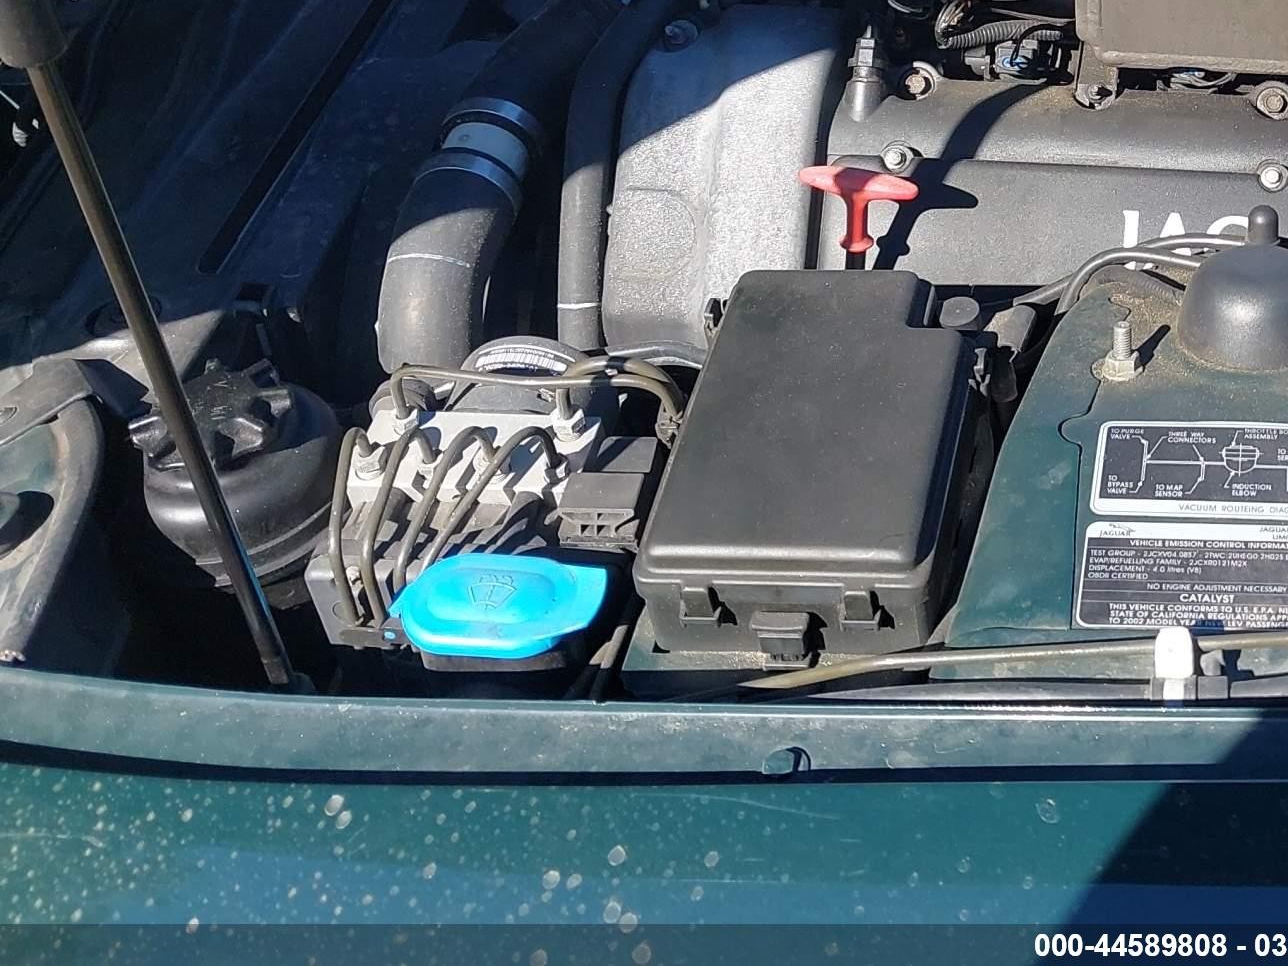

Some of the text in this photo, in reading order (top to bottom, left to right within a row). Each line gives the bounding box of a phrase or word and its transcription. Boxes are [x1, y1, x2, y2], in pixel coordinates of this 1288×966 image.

[1179, 504, 1217, 512] VACUUM
[1221, 505, 1265, 513] ROUTEING
[1130, 539, 1163, 547] VEHICLE
[1165, 540, 1204, 548] EMISSION
[1206, 541, 1246, 549] CONTROL
[1155, 558, 1181, 566] FAMILY
[1111, 572, 1149, 580] CERTIFIED
[1162, 583, 1191, 591] ENGINE
[1193, 584, 1242, 592] ADJUSTMENT
[1243, 585, 1287, 593] NECESSARY
[1180, 594, 1235, 604] CATALYST
[1128, 603, 1164, 611] VEHICLE
[1167, 604, 1218, 612] CONFORMS
[1220, 605, 1233, 613] TO
[1136, 610, 1148, 618] OF
[1151, 611, 1205, 619] CALIFORNIA
[1207, 612, 1267, 621] REGULATIONS
[1145, 618, 1178, 626] MODEL
